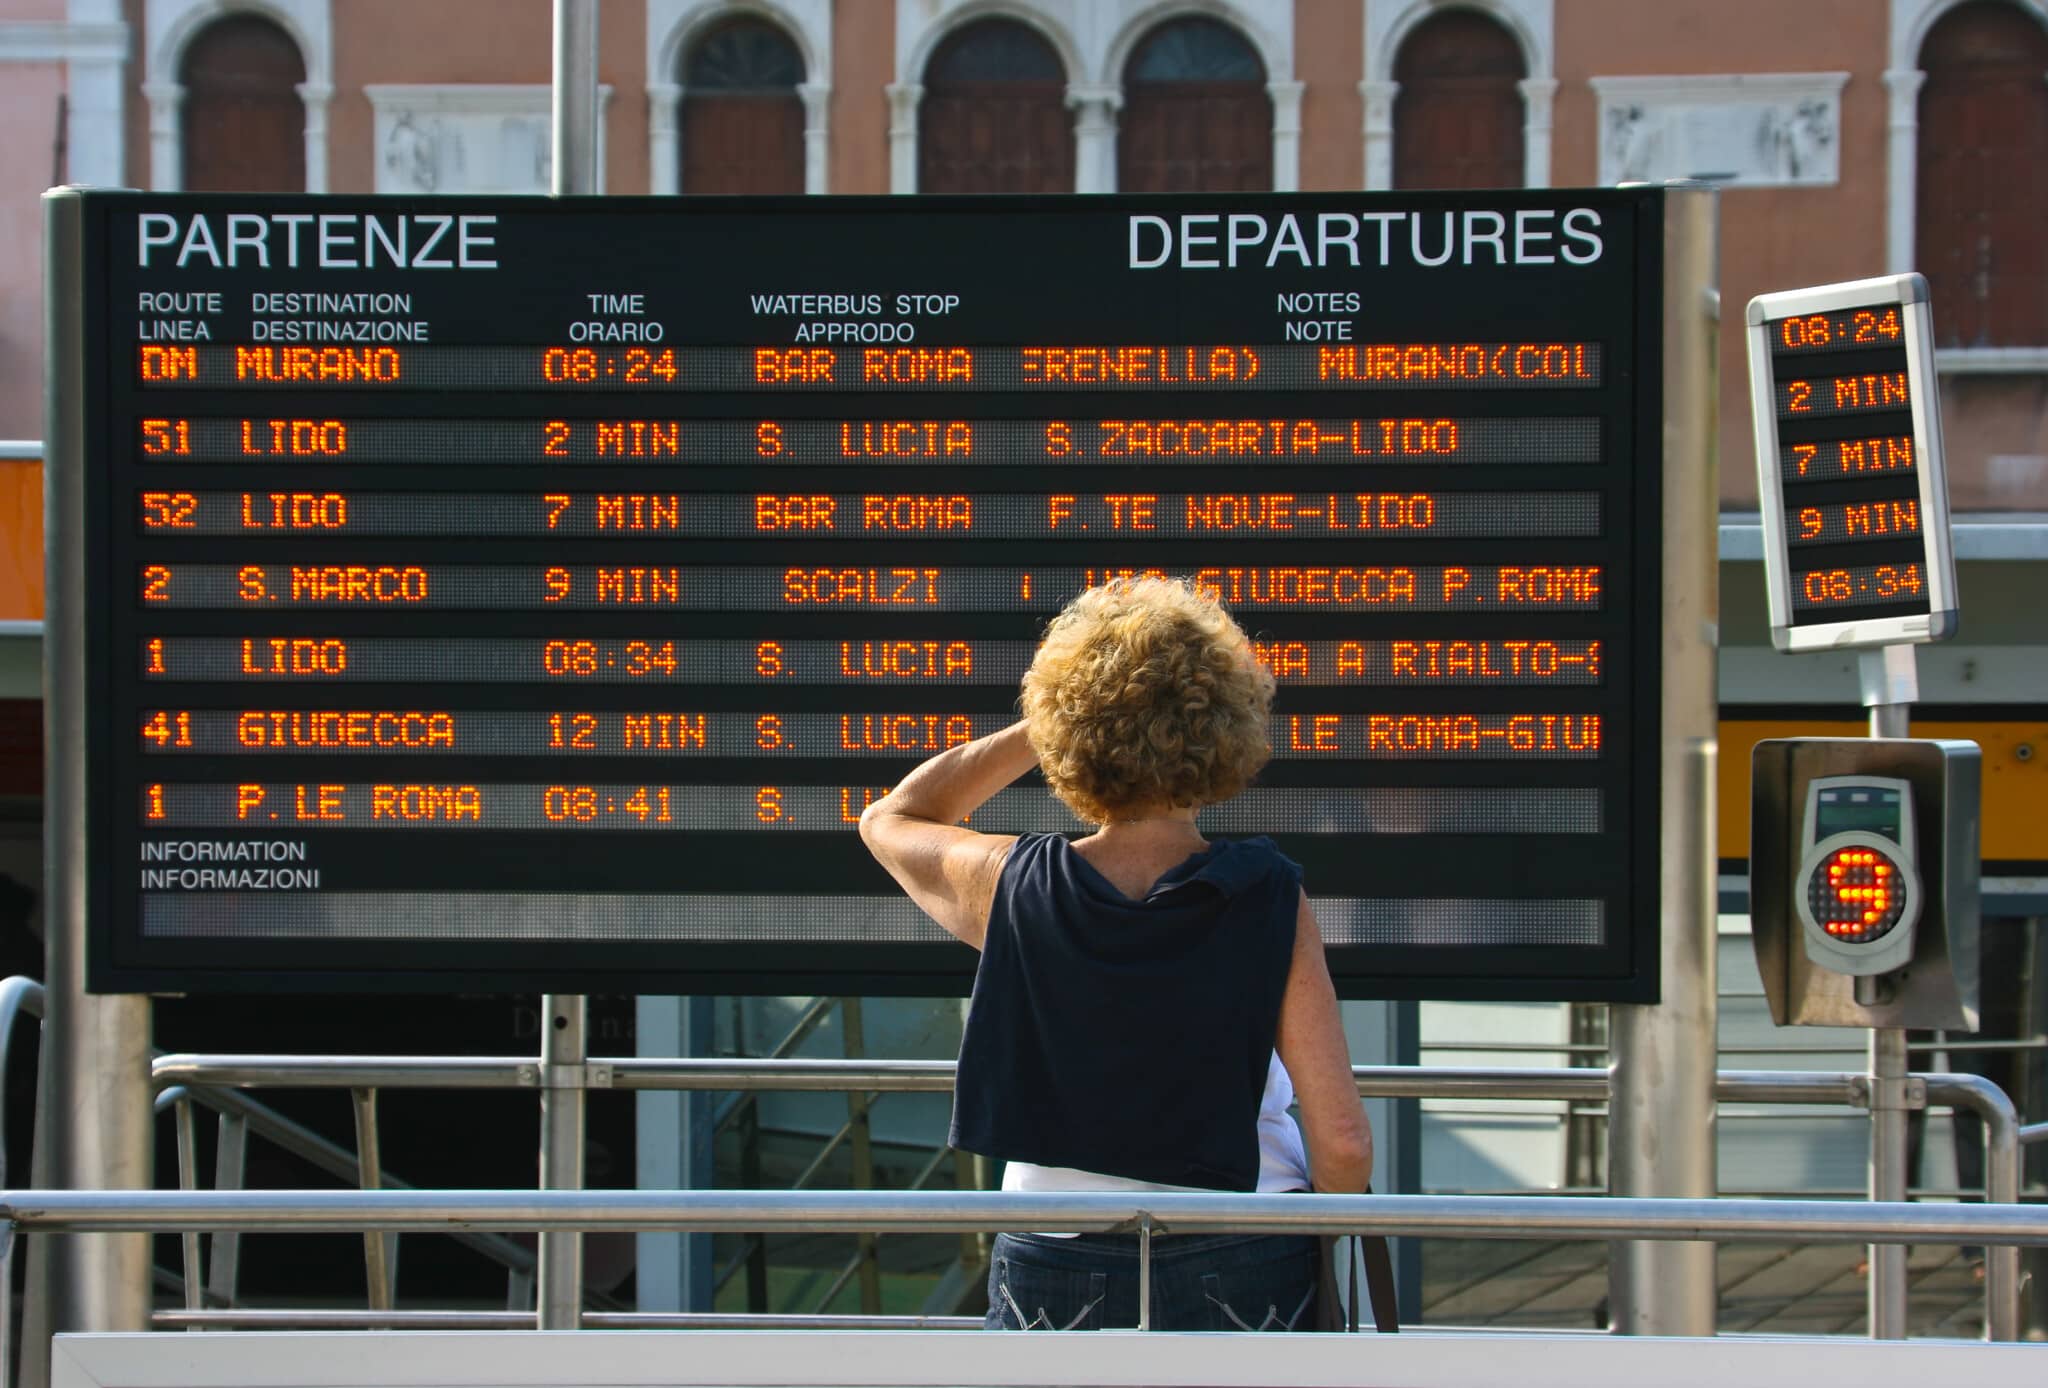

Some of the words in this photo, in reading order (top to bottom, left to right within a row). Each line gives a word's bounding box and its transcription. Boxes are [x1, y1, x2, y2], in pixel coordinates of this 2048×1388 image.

[138, 213, 497, 268] PARTENZE
[1129, 207, 1603, 269] DEPARTURES
[139, 292, 221, 312] ROUTE
[252, 292, 410, 314] DESTINATION
[587, 294, 644, 314] TIME
[750, 294, 882, 315] WATERBUS
[895, 294, 960, 315] STOP
[1278, 292, 1361, 313] NOTES
[139, 320, 210, 340] LINEA
[252, 320, 428, 341] DESTINAZIONE
[569, 321, 663, 342] ORARIO
[794, 322, 915, 343] APPRODO
[1286, 320, 1353, 341] NOTE
[1782, 310, 1900, 347] 08:24
[142, 345, 197, 380] DM
[236, 347, 400, 381] MURANO
[543, 348, 678, 382] 08:24
[755, 348, 836, 382] BAR
[864, 348, 973, 382] ROMA
[1789, 381, 1811, 411] 2
[1835, 374, 1906, 408] MIN
[142, 420, 190, 454] 51
[242, 420, 346, 455] LIDO
[544, 421, 570, 455] 2
[597, 421, 679, 455] MIN
[757, 422, 794, 456] S.
[841, 422, 972, 456] LUCIA
[1046, 419, 1458, 456] S.ZACCARIA-LIDO
[1793, 445, 1817, 475] 7
[1840, 438, 1912, 471] MIN
[143, 493, 197, 527] 52
[242, 493, 346, 528] LIDO
[544, 494, 570, 528] 7
[597, 496, 679, 529] MIN
[756, 495, 836, 530] BAR
[864, 495, 972, 530] ROMA
[1186, 494, 1434, 529] NOVE-LIDO
[1800, 508, 1823, 538] 9
[1846, 501, 1917, 535] MIN
[144, 566, 171, 600] 2
[545, 567, 570, 601] 9
[597, 568, 678, 602] MIN
[784, 568, 940, 603] SCALZI
[1196, 568, 1416, 602] GIUDECCA
[1805, 565, 1921, 602] 08:34
[148, 639, 165, 672] 1
[242, 639, 346, 674] LIDO
[544, 640, 678, 675] 08:34
[757, 641, 793, 676] S.
[841, 641, 972, 676] LUCIA
[1336, 641, 1365, 676] A
[143, 712, 192, 746] 41
[237, 712, 454, 747] GIUDECCA
[549, 713, 598, 748] 12
[624, 714, 706, 749] MIN
[757, 715, 793, 749] S.
[841, 715, 972, 749] LUCIA
[1369, 715, 1600, 751] ROMA-GIU
[148, 784, 165, 819] 1
[372, 784, 481, 821] ROMA
[544, 786, 672, 822] 08:41
[756, 787, 794, 822] S.
[141, 841, 305, 861] INFORMATION
[141, 868, 319, 889] INFORMAZIONI
[1825, 849, 1891, 935] 9
